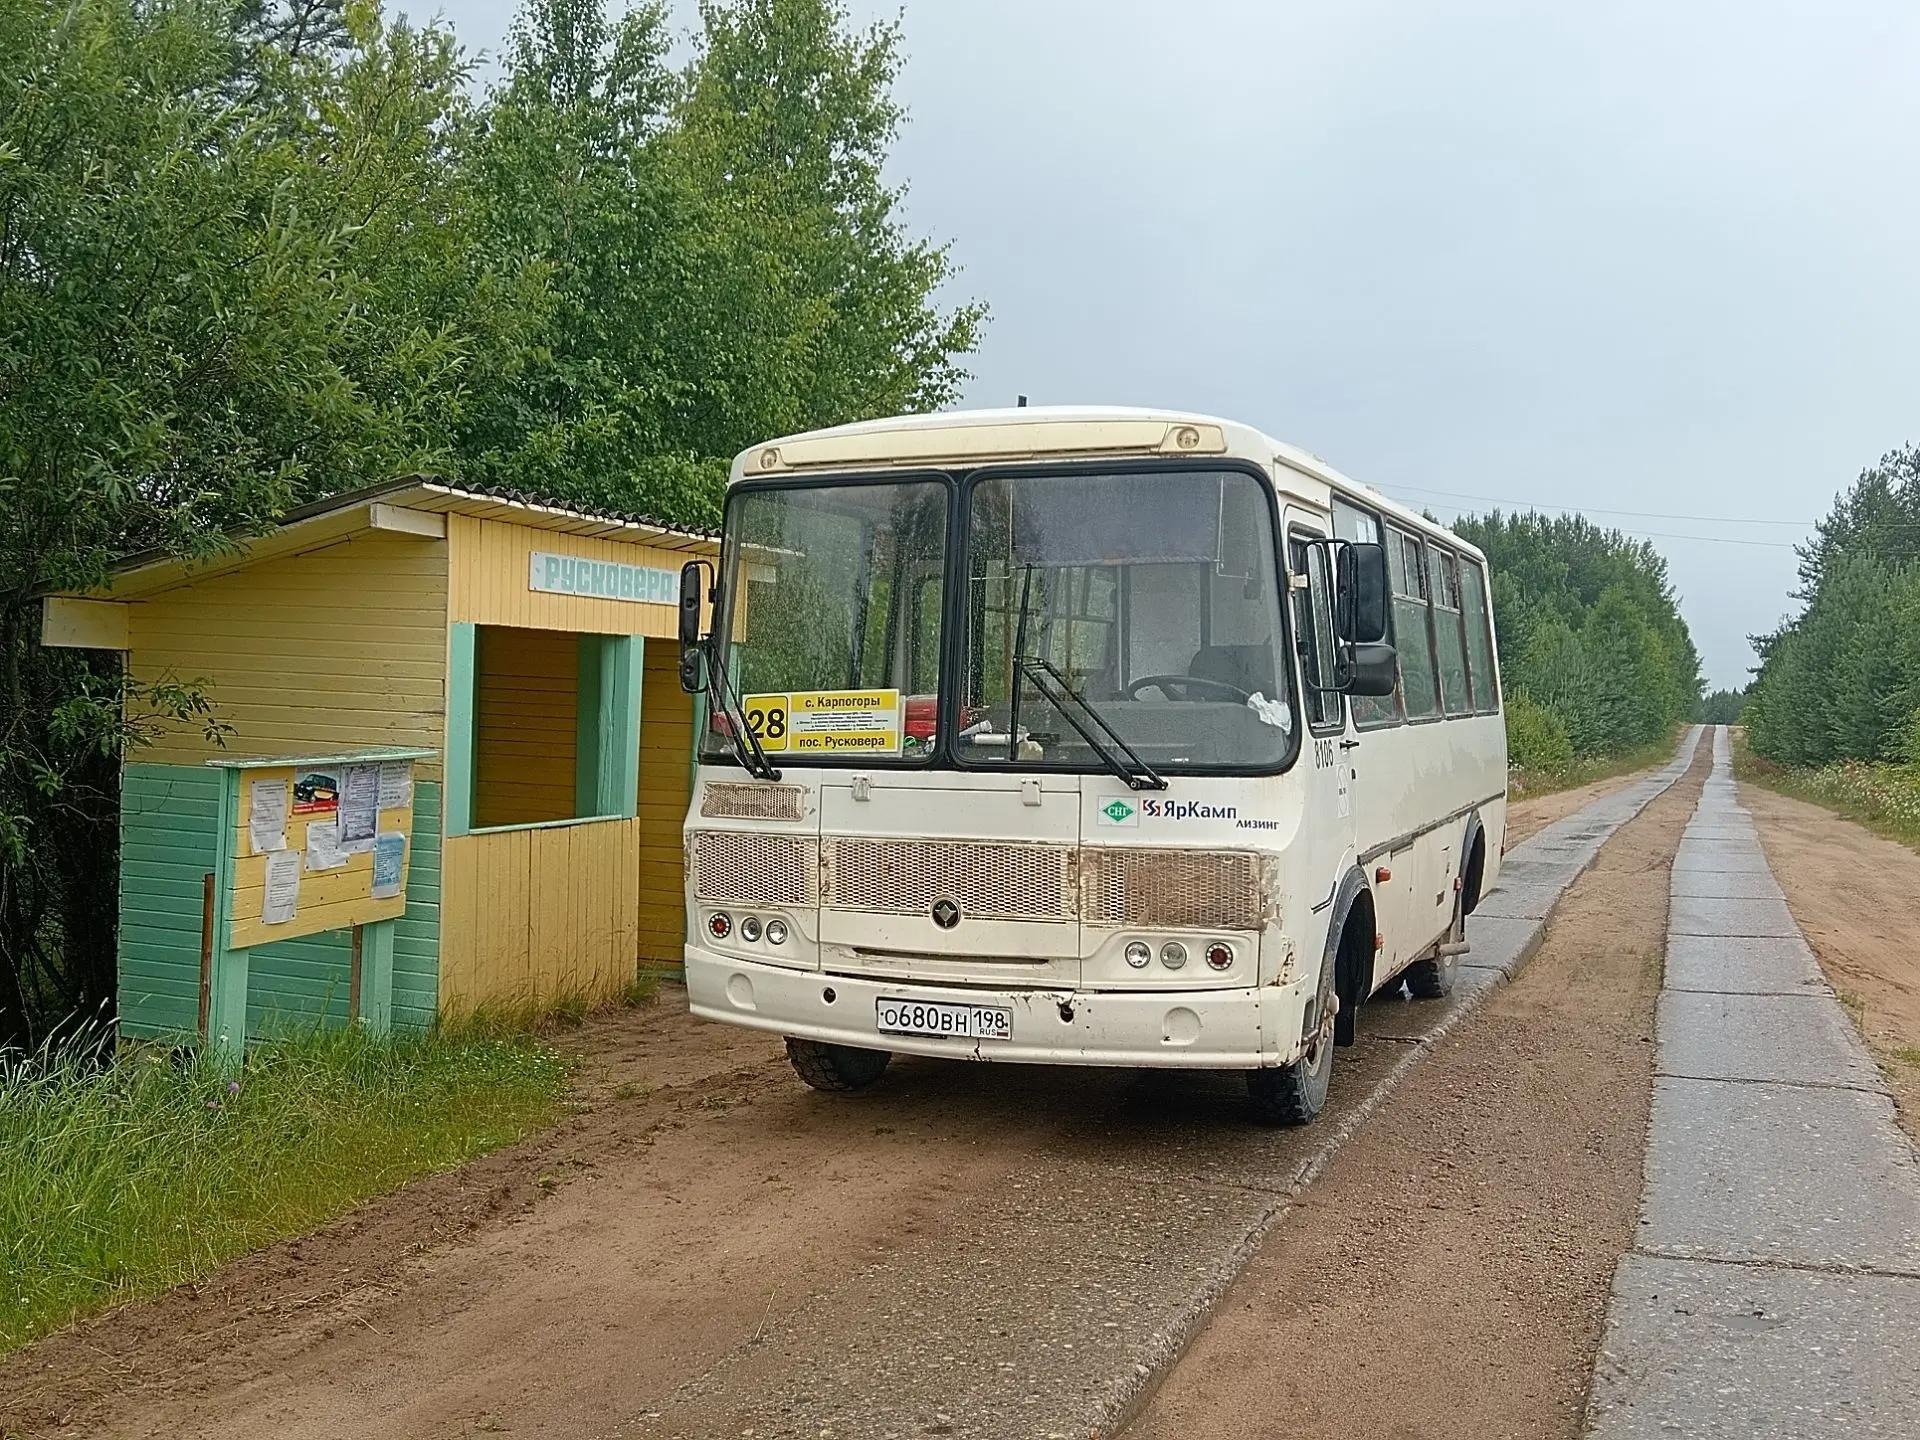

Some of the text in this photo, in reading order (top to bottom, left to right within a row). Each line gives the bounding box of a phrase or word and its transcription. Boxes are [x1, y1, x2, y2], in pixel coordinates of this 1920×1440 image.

[805, 696, 880, 709] с. Карпогоры
[747, 708, 786, 739] 28
[799, 736, 885, 749] пос. Русковера
[1314, 739, 1334, 770] 8106
[1163, 800, 1237, 820] ЯрКамп
[1236, 819, 1280, 830] лизинг
[973, 1010, 1005, 1029] 198
[979, 1028, 997, 1036] RUS
